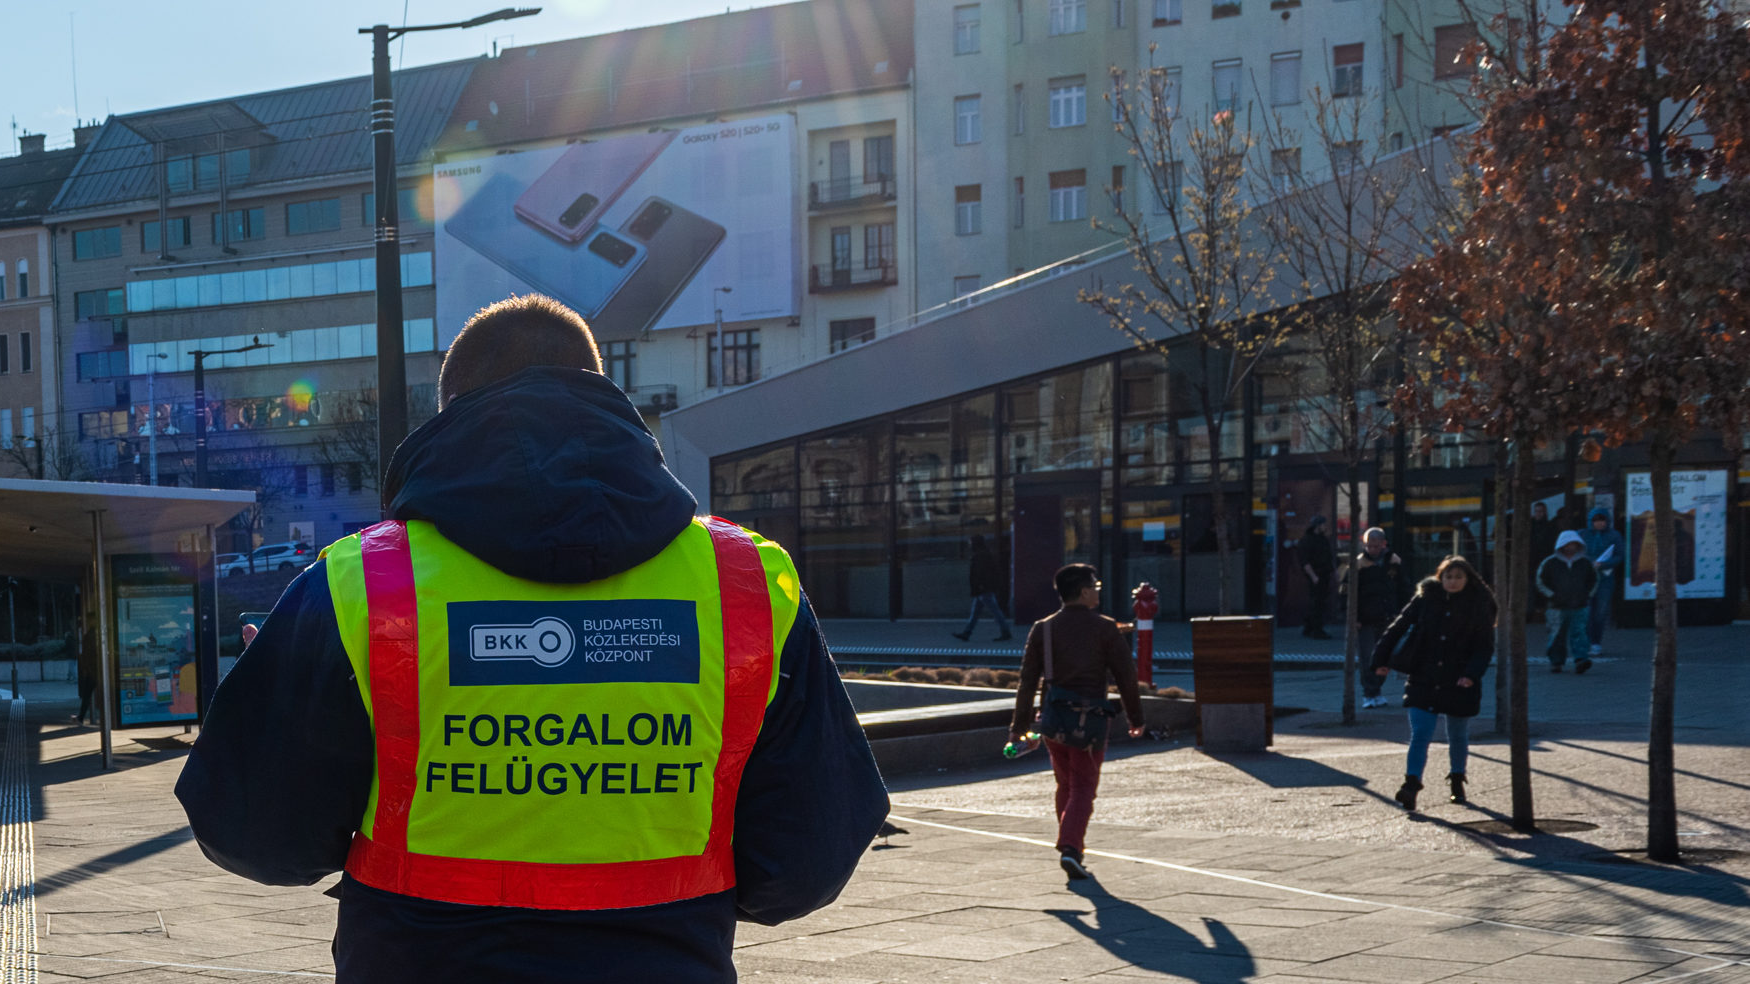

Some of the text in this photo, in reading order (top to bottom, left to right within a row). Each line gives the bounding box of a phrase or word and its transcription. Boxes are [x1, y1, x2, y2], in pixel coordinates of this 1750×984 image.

[682, 132, 718, 144] Galaxy
[437, 165, 482, 177] SAMSUNG
[583, 618, 663, 632] BUDAPESTI
[484, 634, 528, 650] BKK
[584, 631, 681, 647] KÖZLEKEDÉSI
[585, 648, 654, 663] KÖZPONT
[443, 712, 692, 747] FORGALOM
[425, 755, 703, 796] FELÜGYELET
